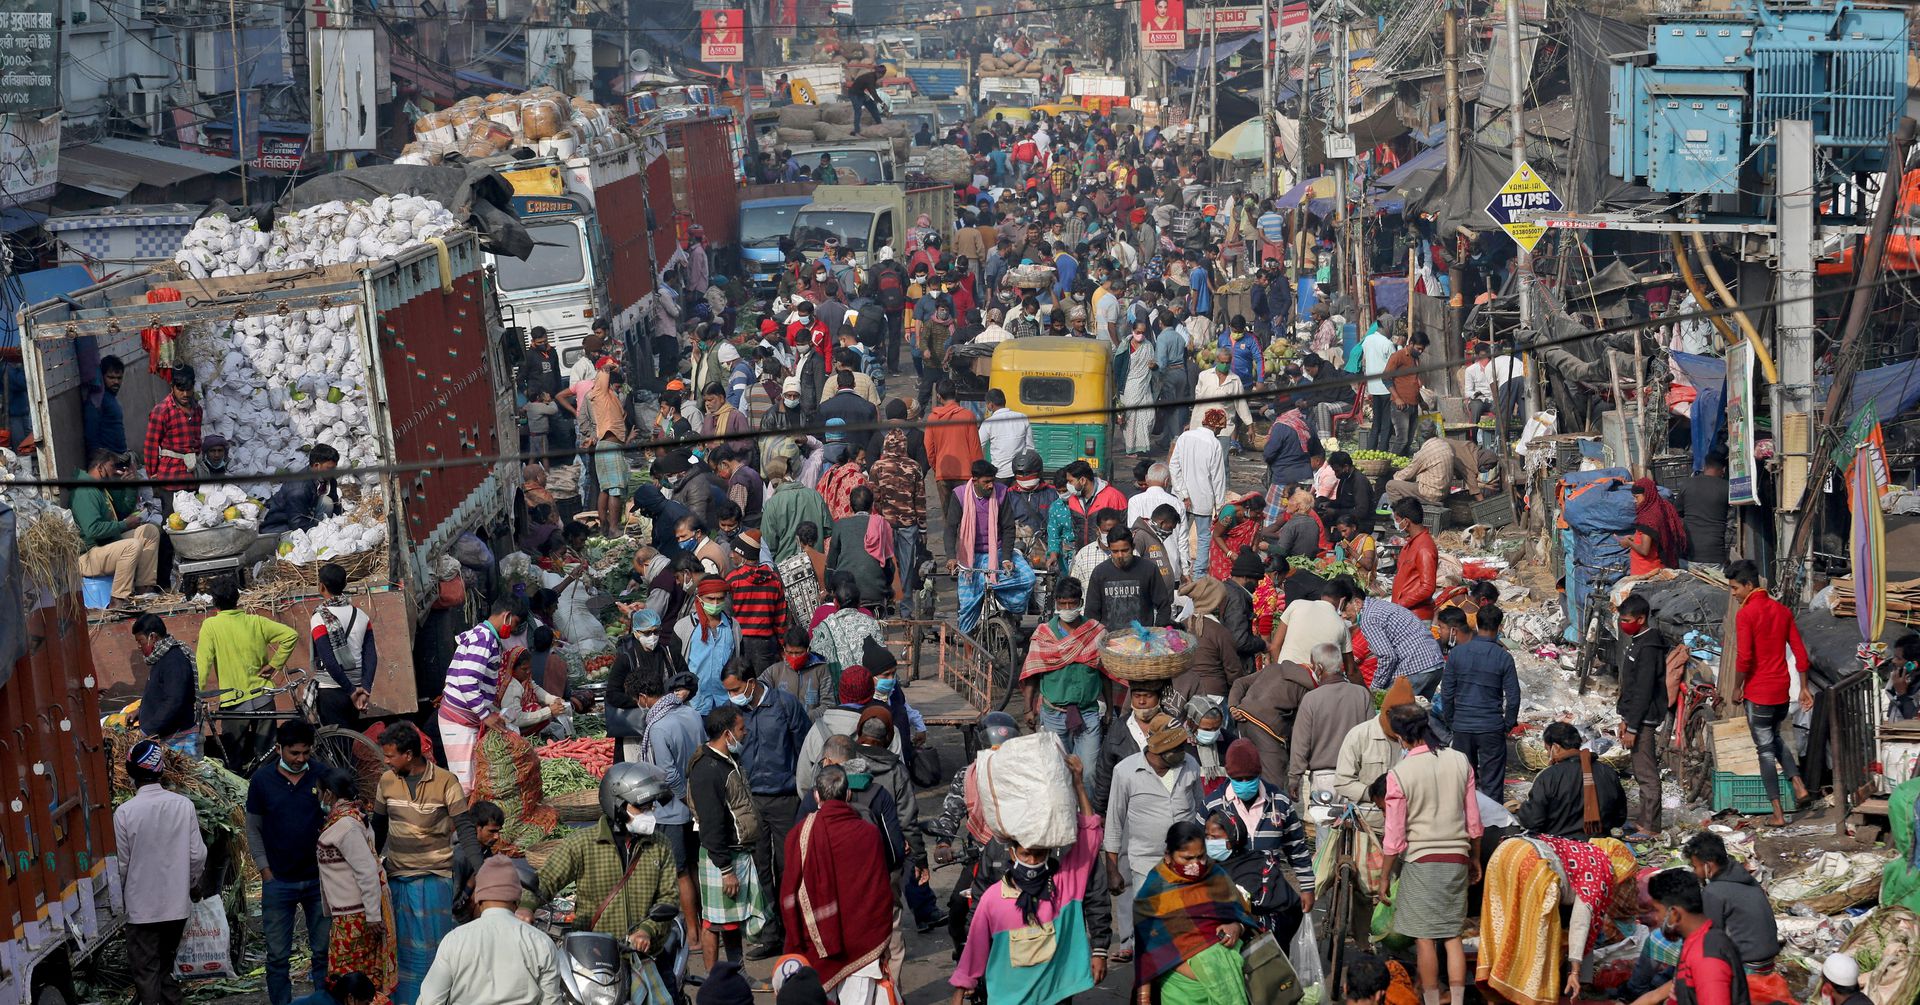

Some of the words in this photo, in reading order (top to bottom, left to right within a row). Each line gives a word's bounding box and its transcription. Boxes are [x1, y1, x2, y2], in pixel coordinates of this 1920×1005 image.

[527, 200, 573, 213] CARRIER
[1501, 192, 1550, 208] IAS/PSC
[1104, 586, 1140, 596] RUSHOUT
